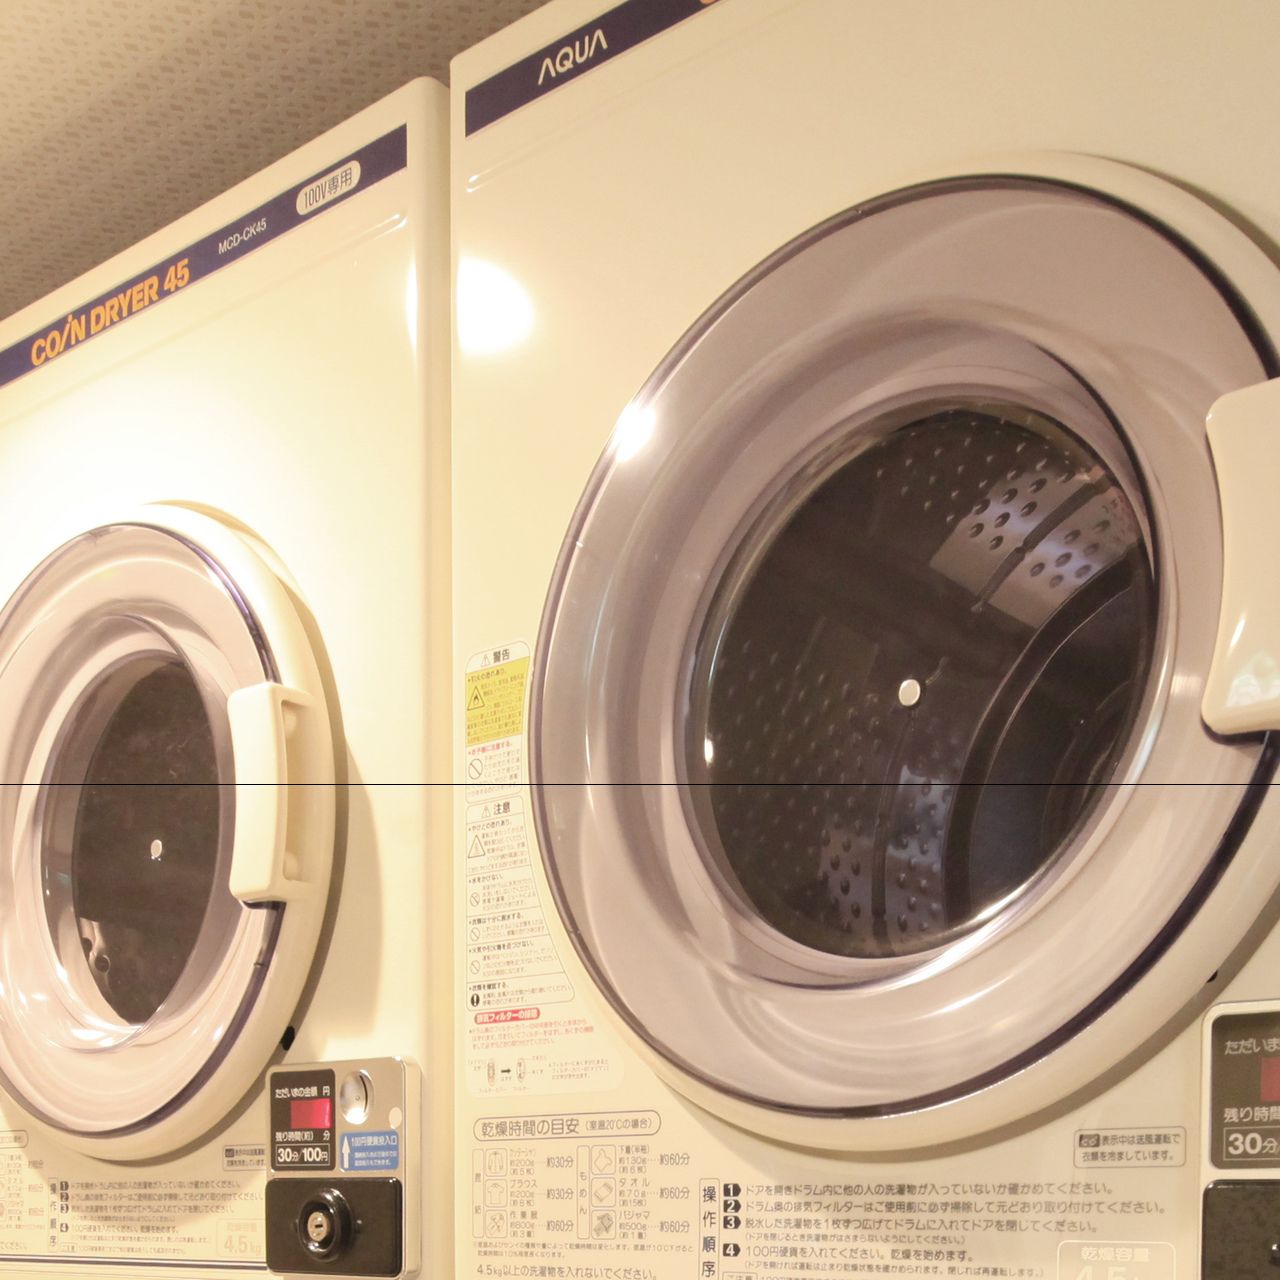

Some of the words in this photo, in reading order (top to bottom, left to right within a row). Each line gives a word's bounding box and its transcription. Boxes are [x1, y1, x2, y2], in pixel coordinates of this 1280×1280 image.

[538, 29, 609, 85] AQUA
[303, 166, 354, 209] 100V専用
[90, 277, 159, 335] DRYER
[163, 258, 190, 293] 45
[481, 1118, 579, 1138] 乾燥時間の目安
[701, 1185, 718, 1278] 操作順序
